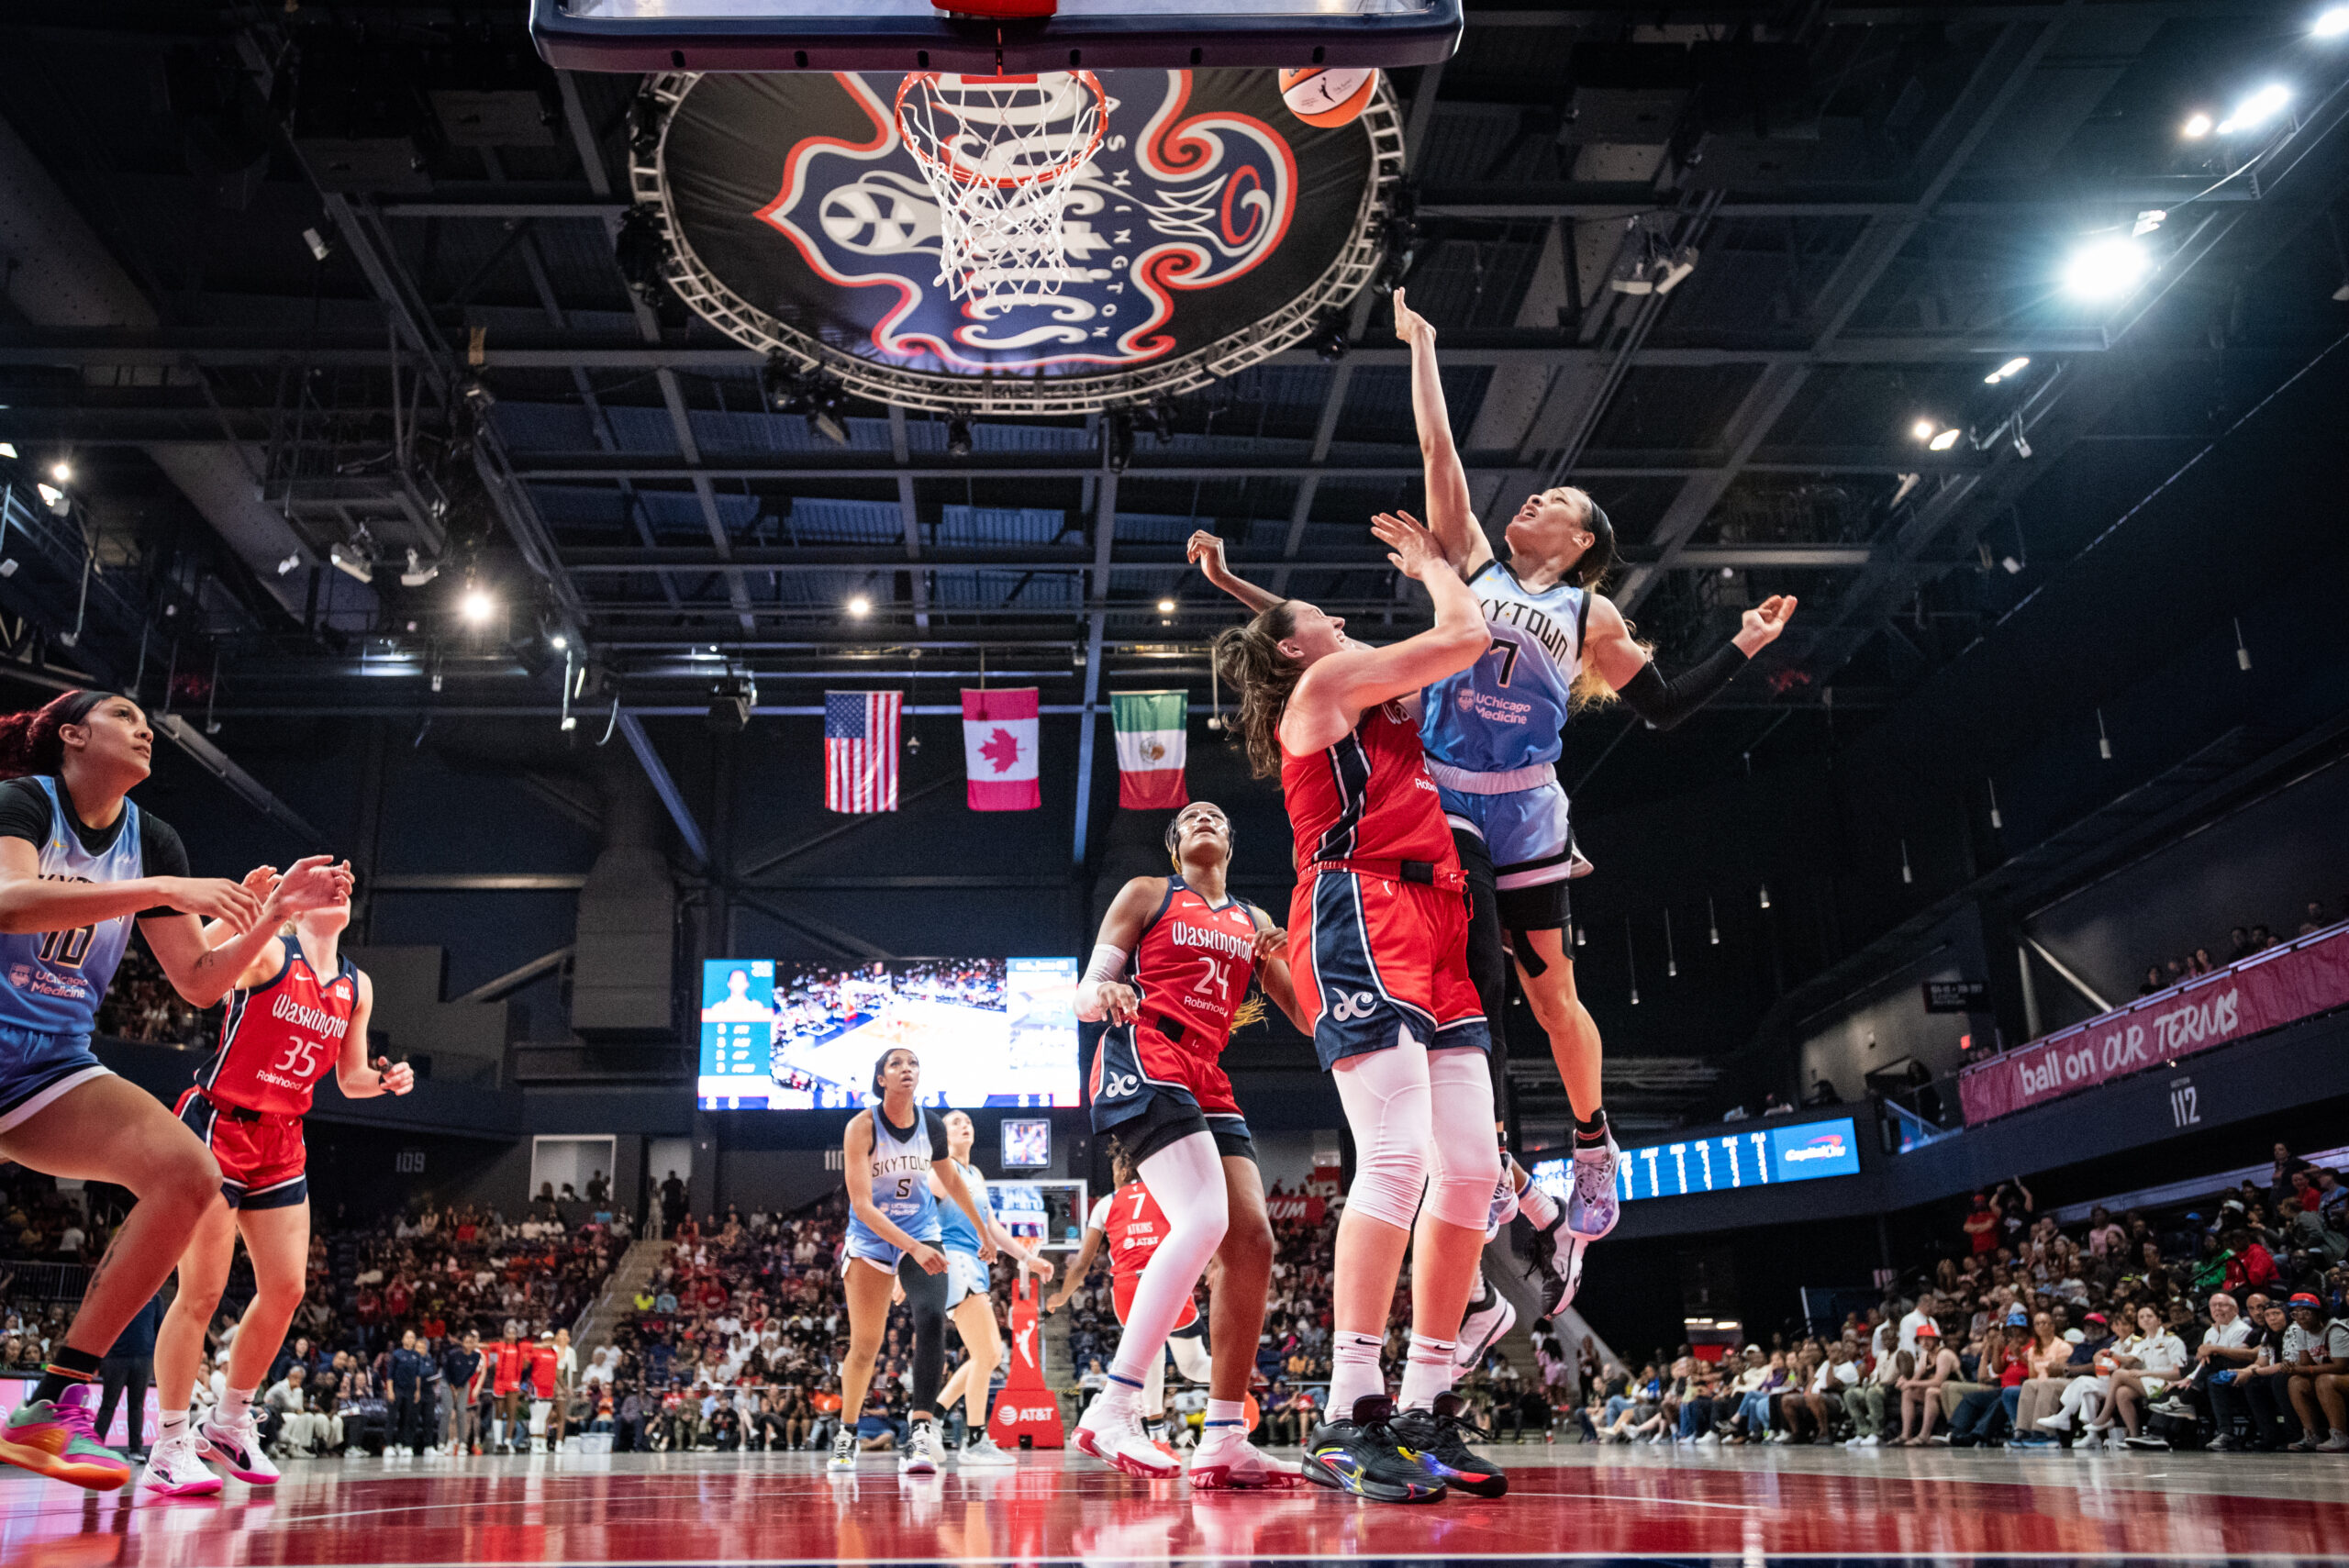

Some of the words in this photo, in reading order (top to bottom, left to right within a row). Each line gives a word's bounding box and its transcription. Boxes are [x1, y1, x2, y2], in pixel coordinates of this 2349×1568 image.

[1092, 95, 1132, 338] ASHINGTON
[1488, 637, 1521, 688] 7
[1475, 694, 1531, 712] UChicago
[1475, 705, 1528, 725] Medicine
[35, 970, 88, 987] UChicago
[1193, 956, 1231, 1000] 24
[31, 981, 85, 998] Medicine
[2019, 1050, 2062, 1096] ball
[2065, 1048, 2096, 1081] on
[2102, 1026, 2147, 1072] OUR
[2153, 987, 2239, 1054] TERMS
[274, 1035, 324, 1077] 35
[2171, 1086, 2200, 1128] 112
[395, 1151, 426, 1173] 109
[1128, 1193, 1146, 1220] 7
[1127, 1222, 1153, 1236] ATKINS
[1136, 1236, 1159, 1246] AT&T
[1019, 1407, 1054, 1421] AT&T
